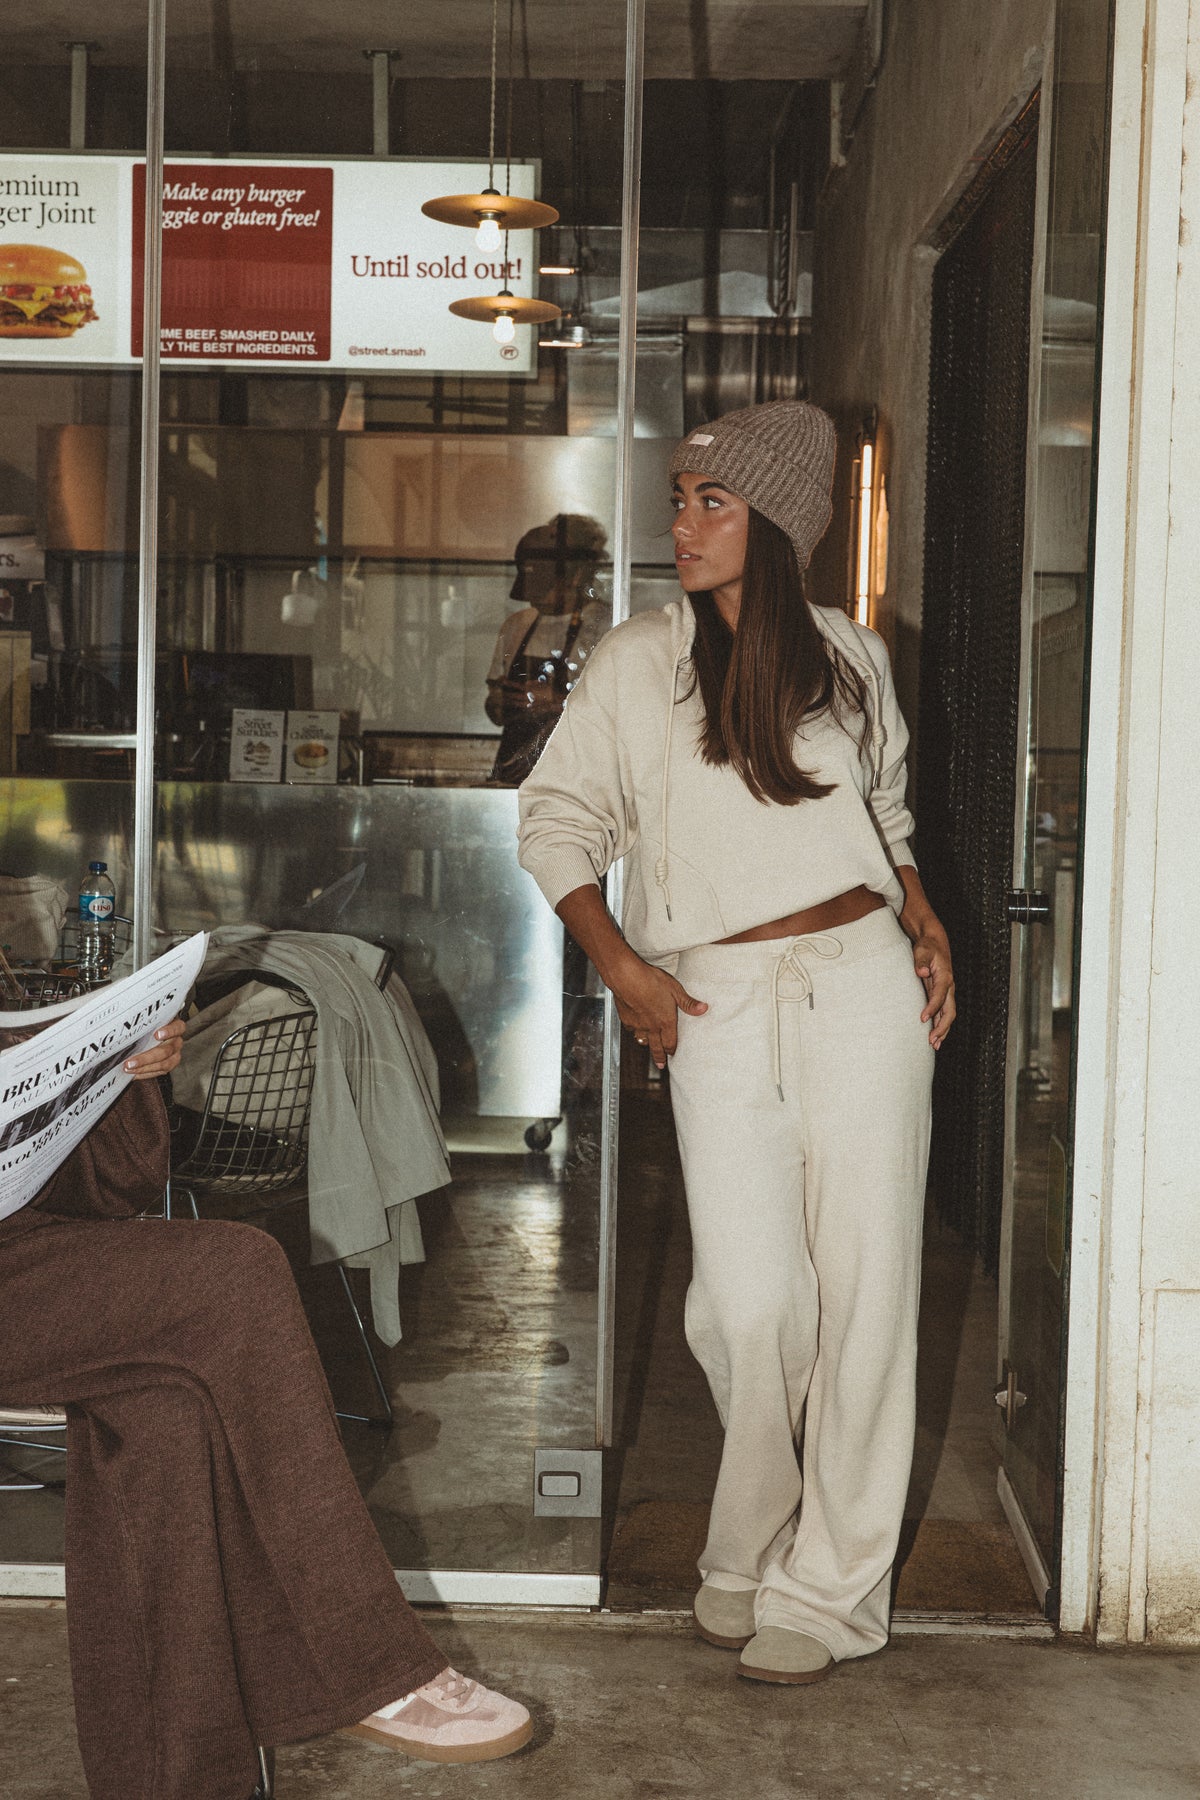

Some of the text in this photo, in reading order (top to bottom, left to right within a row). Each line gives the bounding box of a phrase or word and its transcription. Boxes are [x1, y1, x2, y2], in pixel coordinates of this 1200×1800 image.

[162, 182, 306, 208] Make any burger
[36, 202, 96, 229] Joint
[202, 210, 222, 225] or
[221, 207, 277, 231] gluten
[275, 208, 320, 231] free!
[351, 255, 522, 280] Until sold out!
[160, 328, 317, 342] IME BEEF, SMASHED DAILY.
[160, 341, 318, 355] LY THE BEST INGREDIENTS.
[348, 345, 426, 357] @street.smash
[2, 1028, 116, 1103] BREAKING
[119, 988, 177, 1033] NEWS
